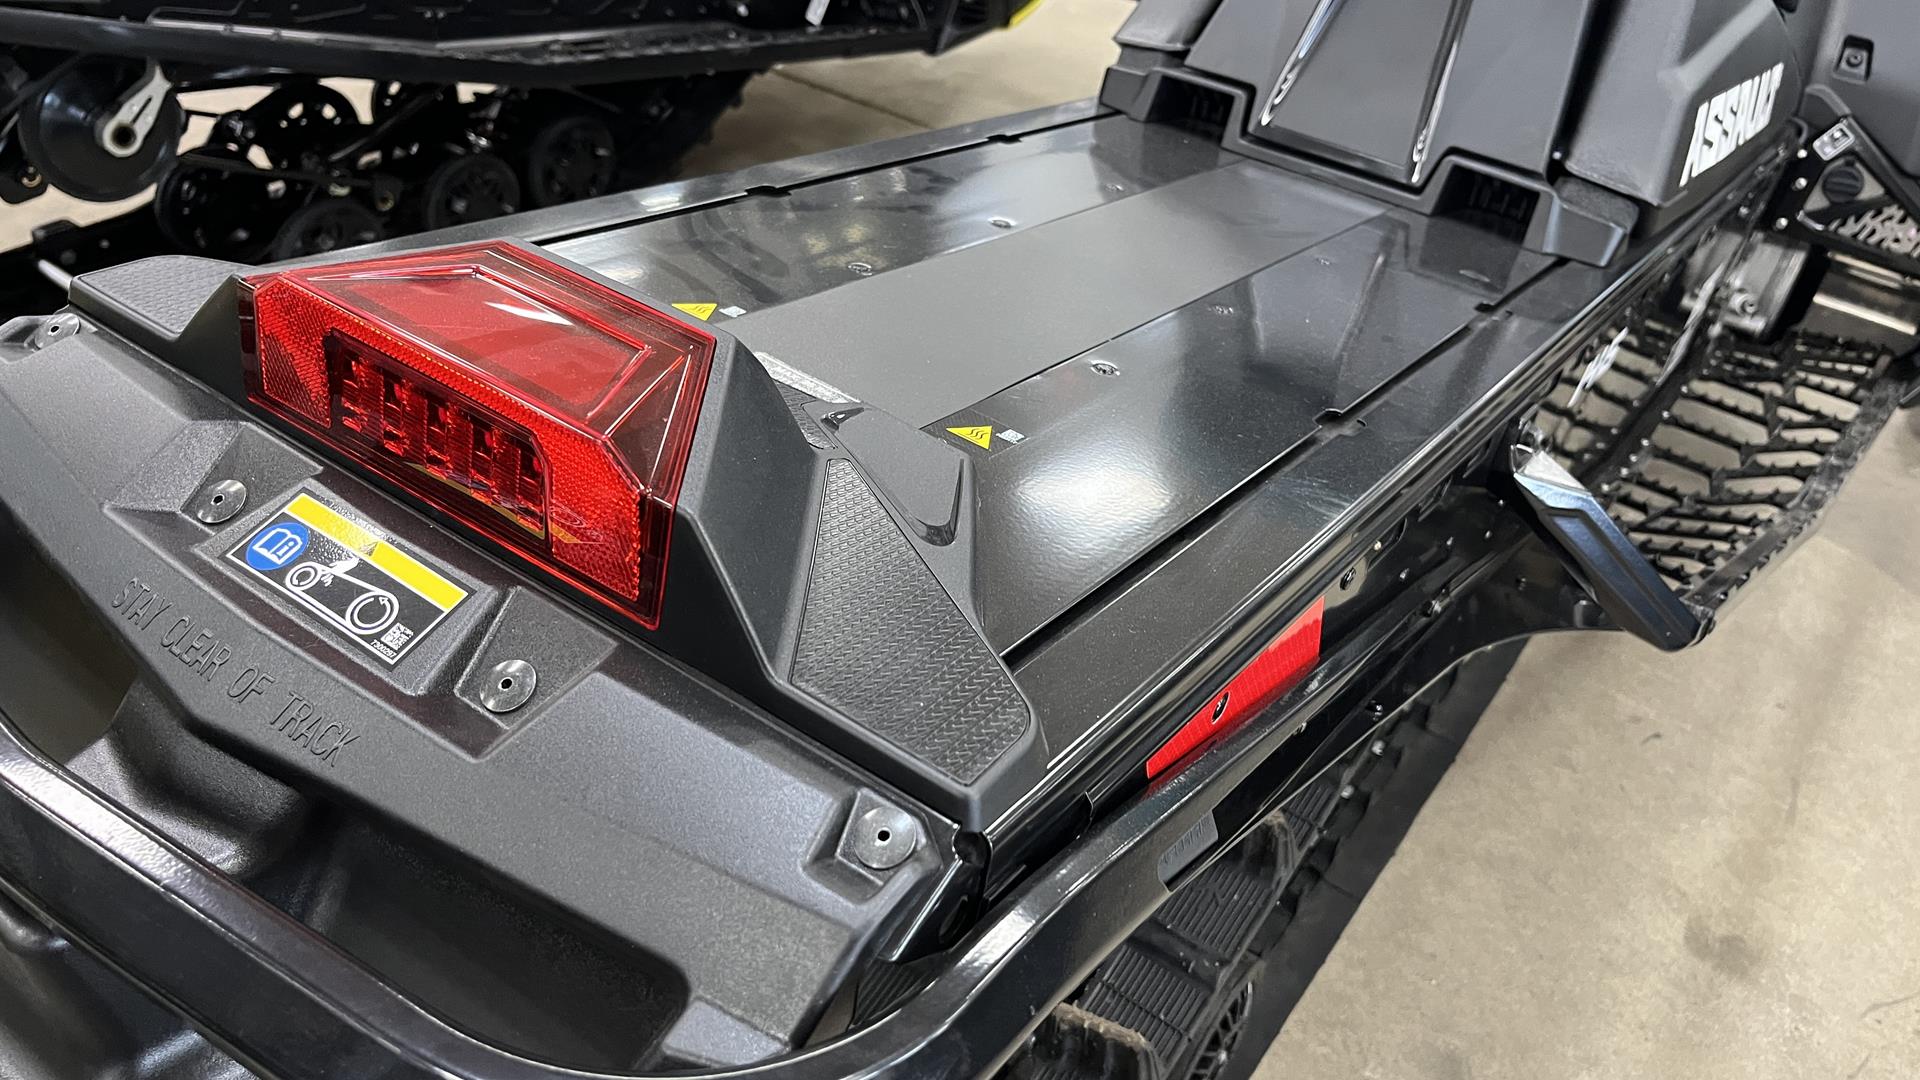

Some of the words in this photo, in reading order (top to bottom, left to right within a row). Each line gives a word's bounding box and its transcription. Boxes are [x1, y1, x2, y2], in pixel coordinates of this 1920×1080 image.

[1679, 61, 1784, 187] ASSAULT
[111, 577, 173, 631] STAY
[160, 615, 232, 682] CLEAR
[226, 667, 276, 704] OF
[269, 691, 361, 768] TRACK
